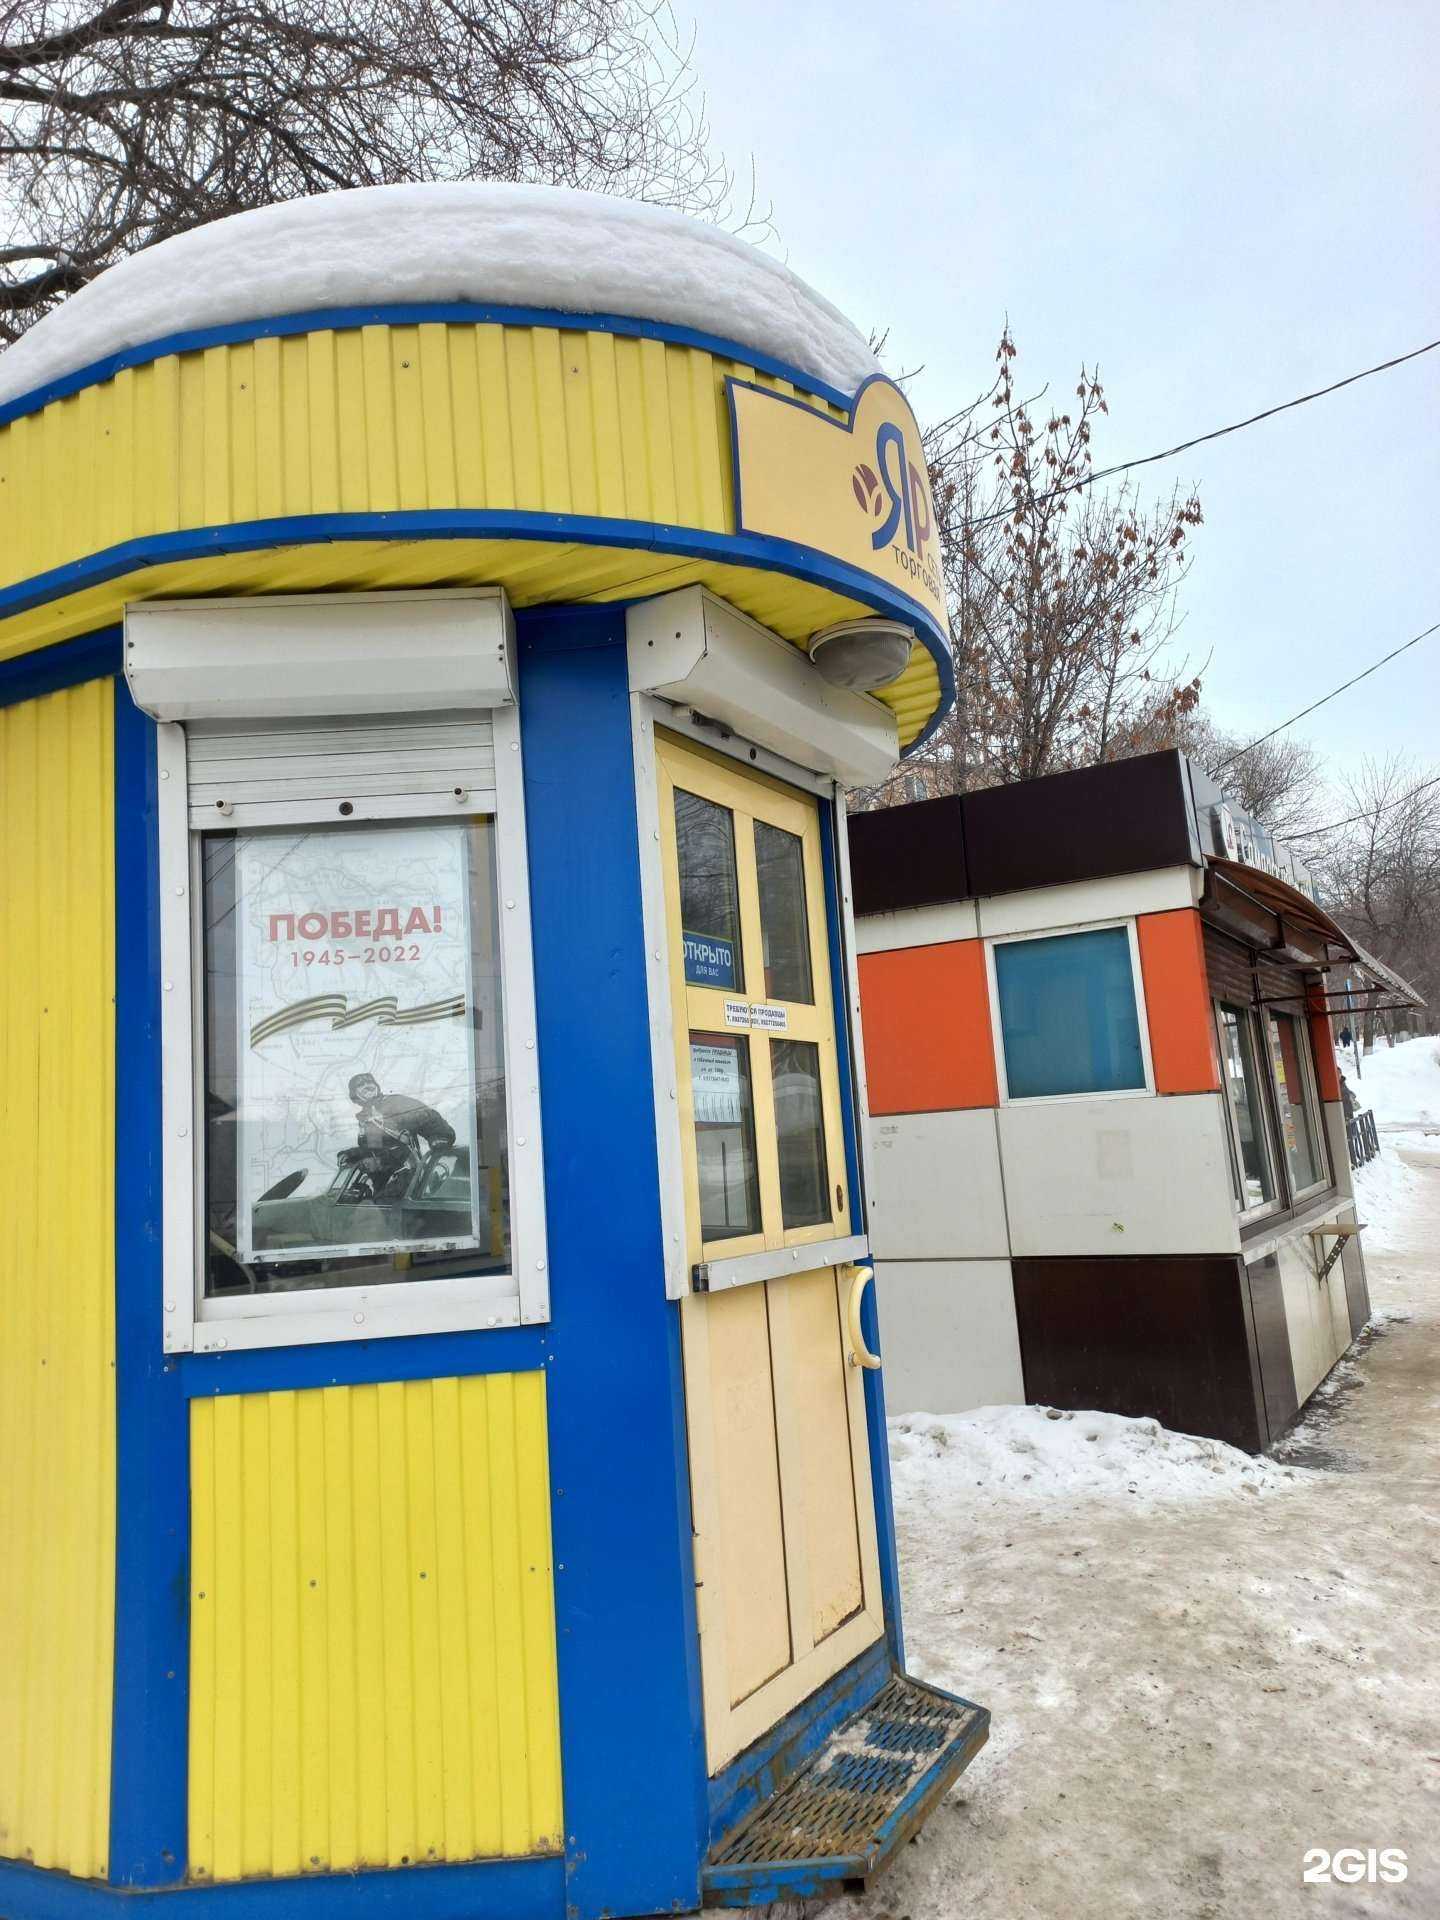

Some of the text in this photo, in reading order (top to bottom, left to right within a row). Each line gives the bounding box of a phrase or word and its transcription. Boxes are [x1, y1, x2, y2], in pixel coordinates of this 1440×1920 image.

[269, 906, 443, 942] ПОБЕДА!
[695, 964, 720, 977] ДЛЯ ВАС
